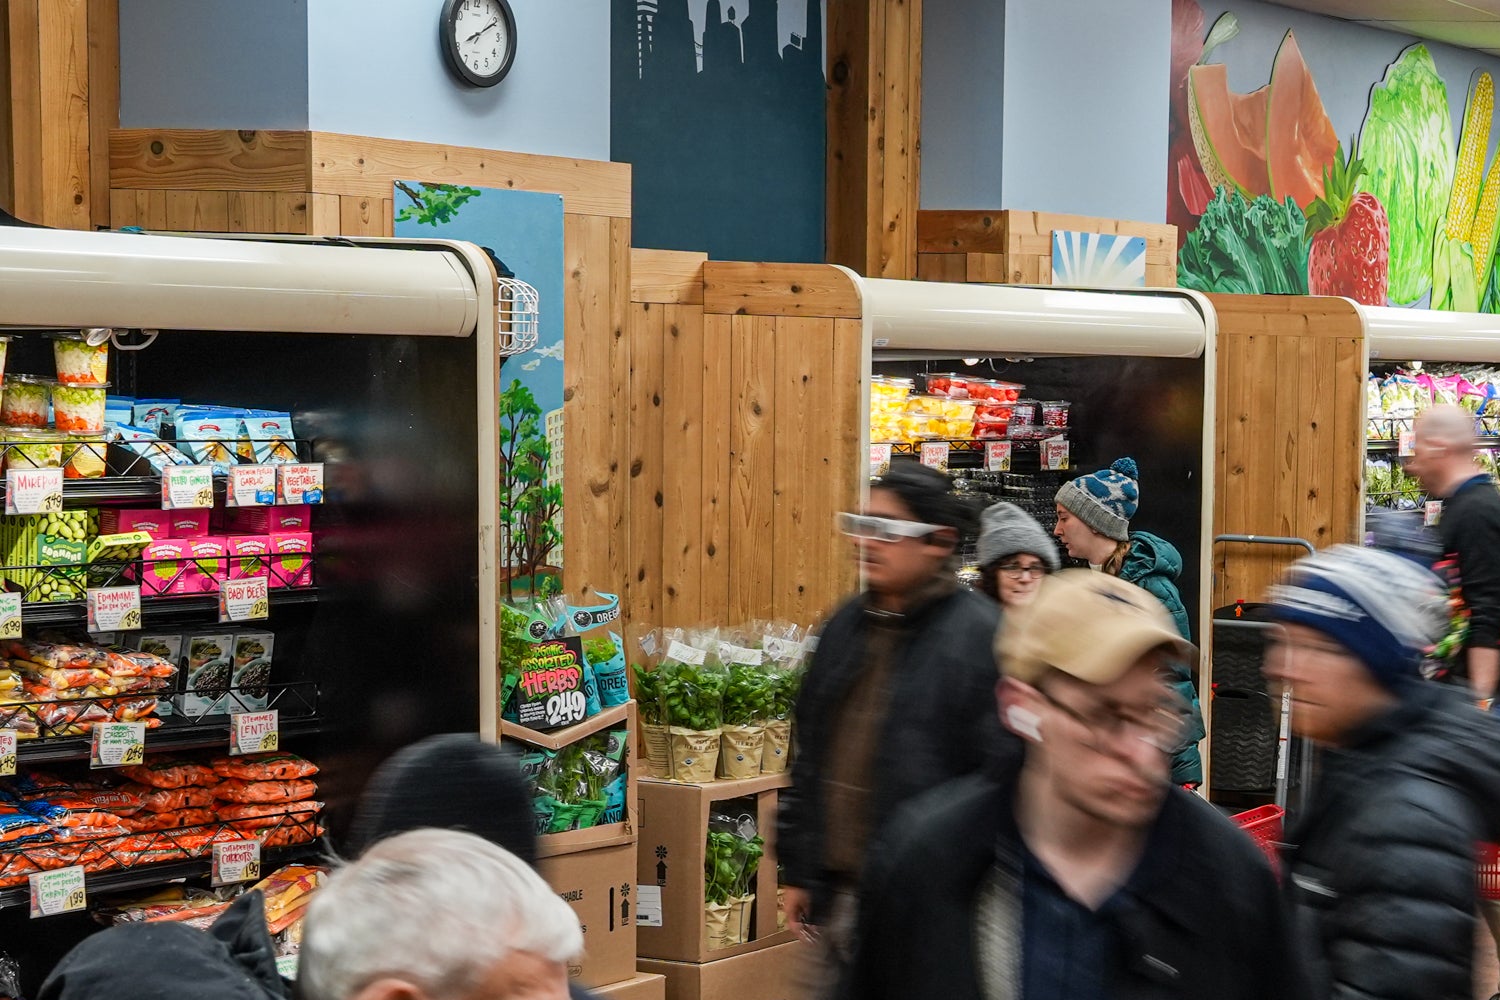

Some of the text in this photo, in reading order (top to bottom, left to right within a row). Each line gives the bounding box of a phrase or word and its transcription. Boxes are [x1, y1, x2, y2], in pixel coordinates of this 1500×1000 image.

[495, 32, 501, 43] 3
[491, 48, 497, 58] 4
[473, 60, 479, 70] 6
[484, 58, 489, 68] 5
[228, 584, 267, 600] BABY BEETS
[596, 606, 620, 624] OREG
[521, 653, 574, 671] ASSORTED
[522, 668, 579, 697] HERBS
[560, 889, 584, 902] SHABLE
